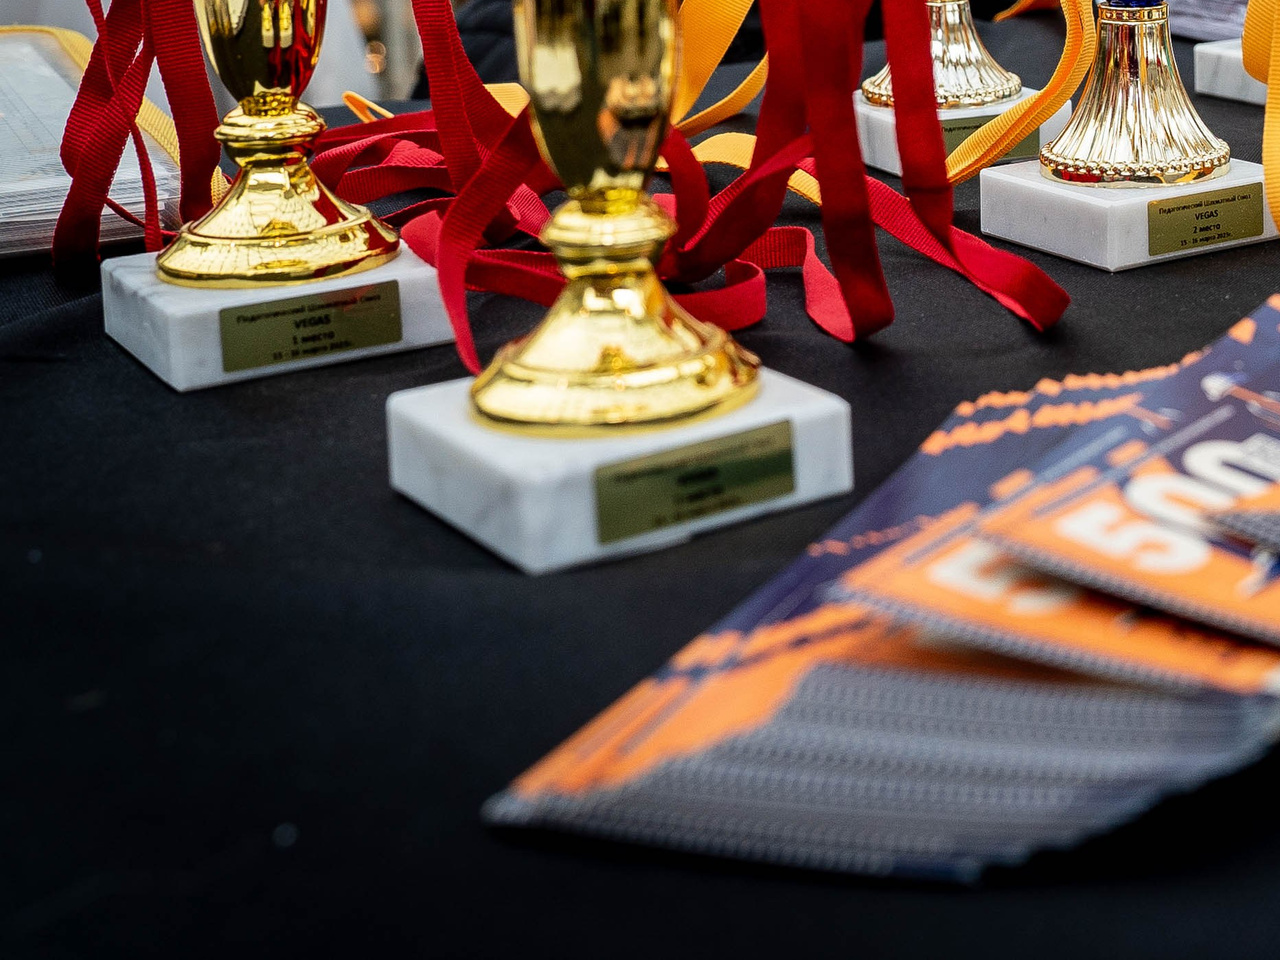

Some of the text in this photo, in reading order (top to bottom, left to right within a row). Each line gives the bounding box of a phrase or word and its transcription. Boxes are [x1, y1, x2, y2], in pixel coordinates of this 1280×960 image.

[1195, 209, 1219, 221] VEGAS
[1199, 223, 1221, 233] место
[294, 313, 332, 329] VEGAS
